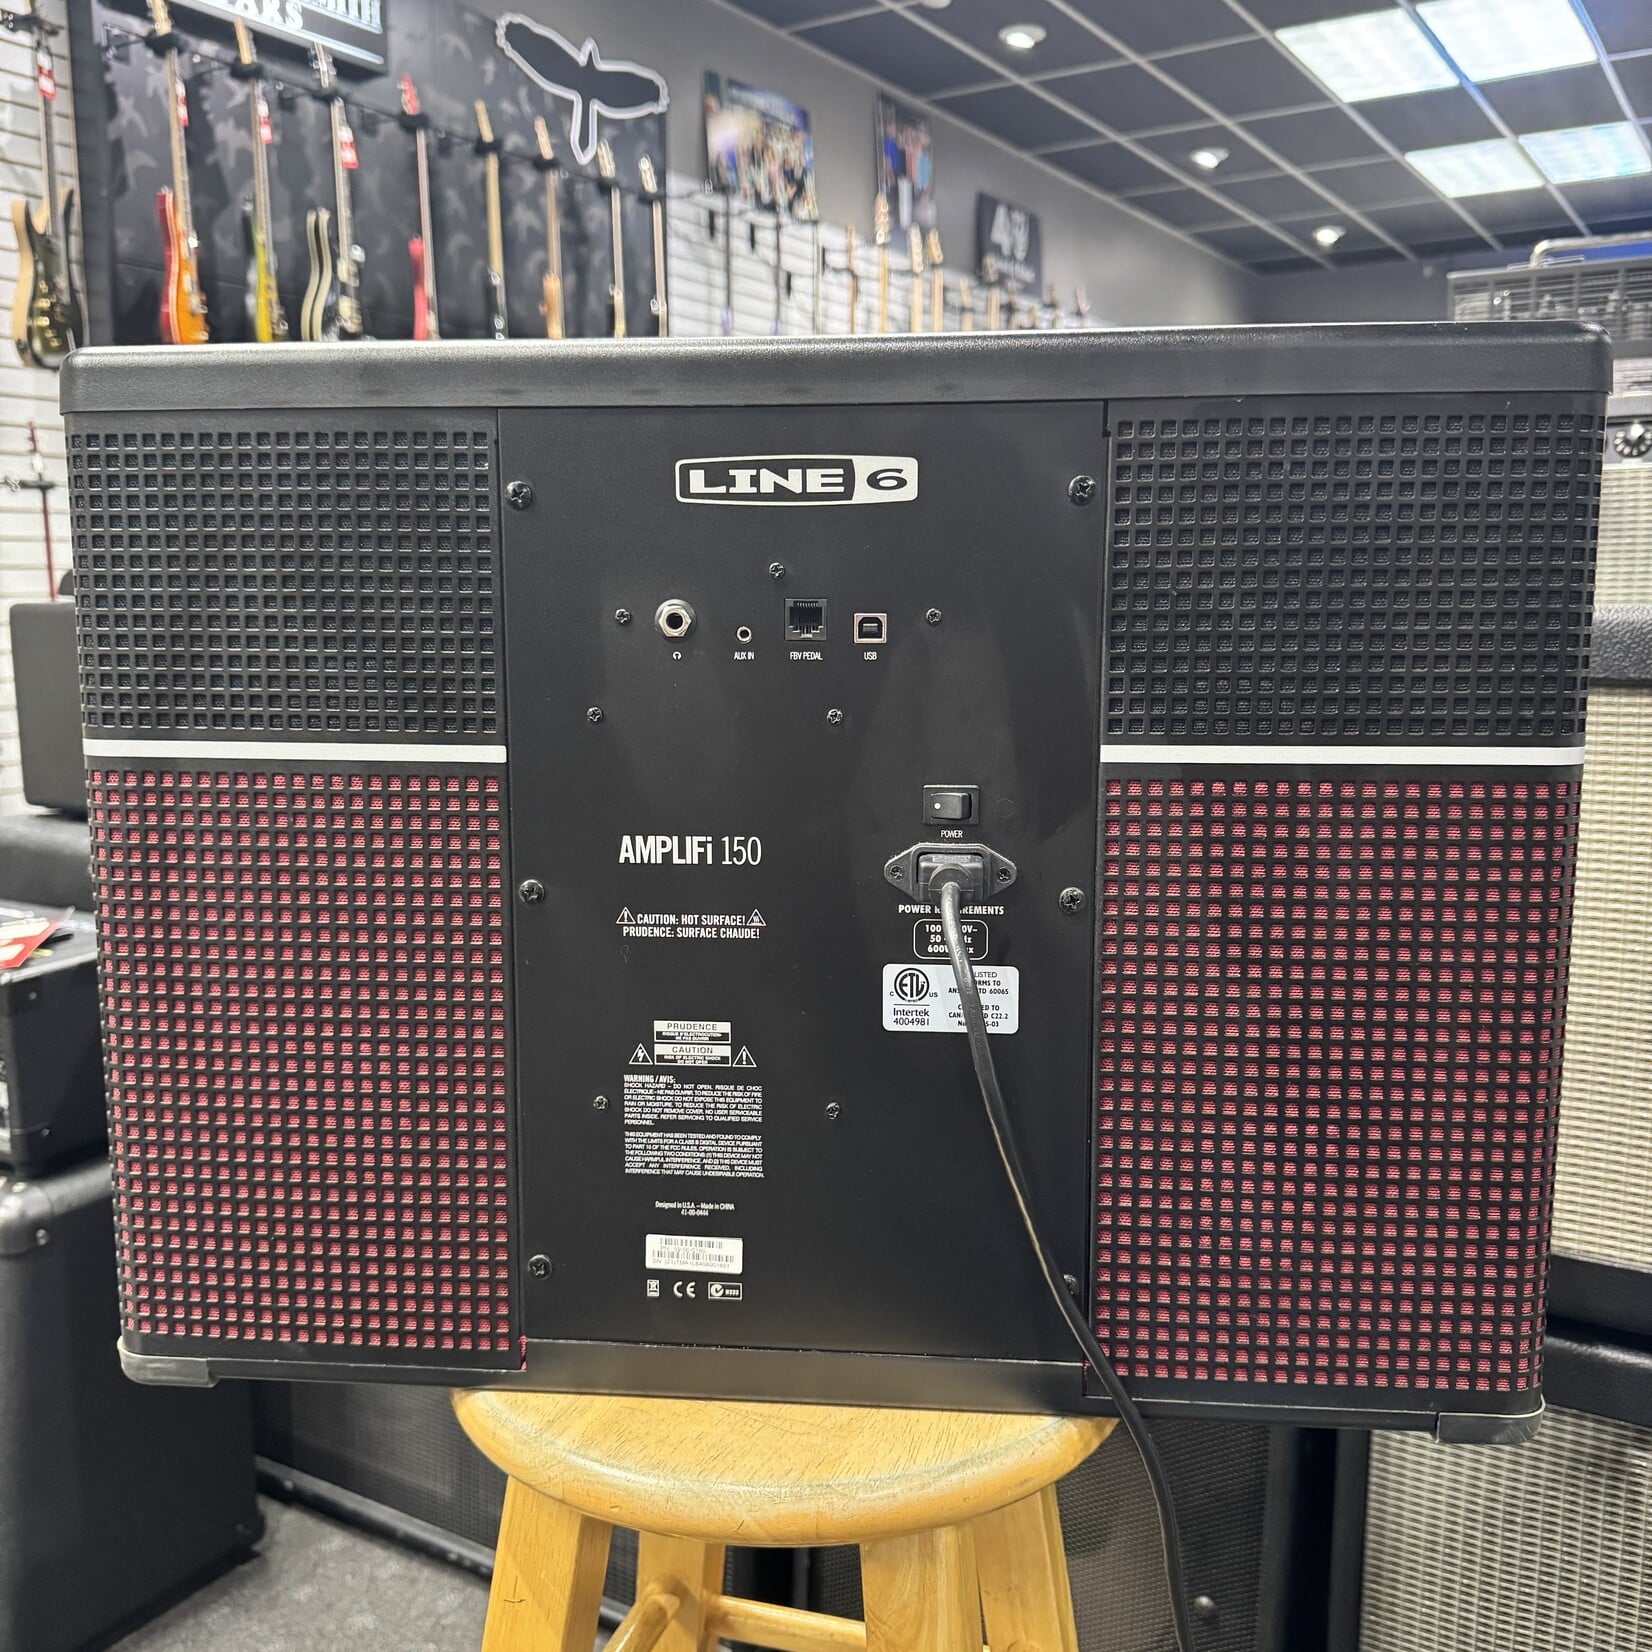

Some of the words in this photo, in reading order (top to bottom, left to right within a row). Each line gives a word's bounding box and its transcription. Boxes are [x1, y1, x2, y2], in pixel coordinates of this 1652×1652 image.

[689, 468, 845, 494] LINE
[867, 468, 908, 491] 6
[734, 652, 747, 660] AUX
[748, 652, 754, 660] IN
[790, 652, 802, 660] FBV
[803, 652, 822, 661] PEDAL
[864, 652, 877, 661] USB
[940, 830, 963, 838] POWER
[619, 836, 712, 864] AMPLIFi
[721, 836, 762, 866] 150
[898, 904, 932, 914] POWER
[637, 914, 678, 924] CAUTION:
[682, 914, 699, 925] HOT
[701, 914, 746, 926] SURFACE!
[623, 926, 674, 938] PRUDENCE:
[676, 927, 718, 938] SURFACE
[720, 928, 760, 938] CHAUDE!
[926, 924, 942, 932] 100
[930, 934, 942, 942] 50
[894, 1008, 930, 1017] Intertek
[667, 1022, 718, 1031] PRUDENCE
[894, 1018, 930, 1026] 4004981
[624, 1074, 654, 1082] WARNING
